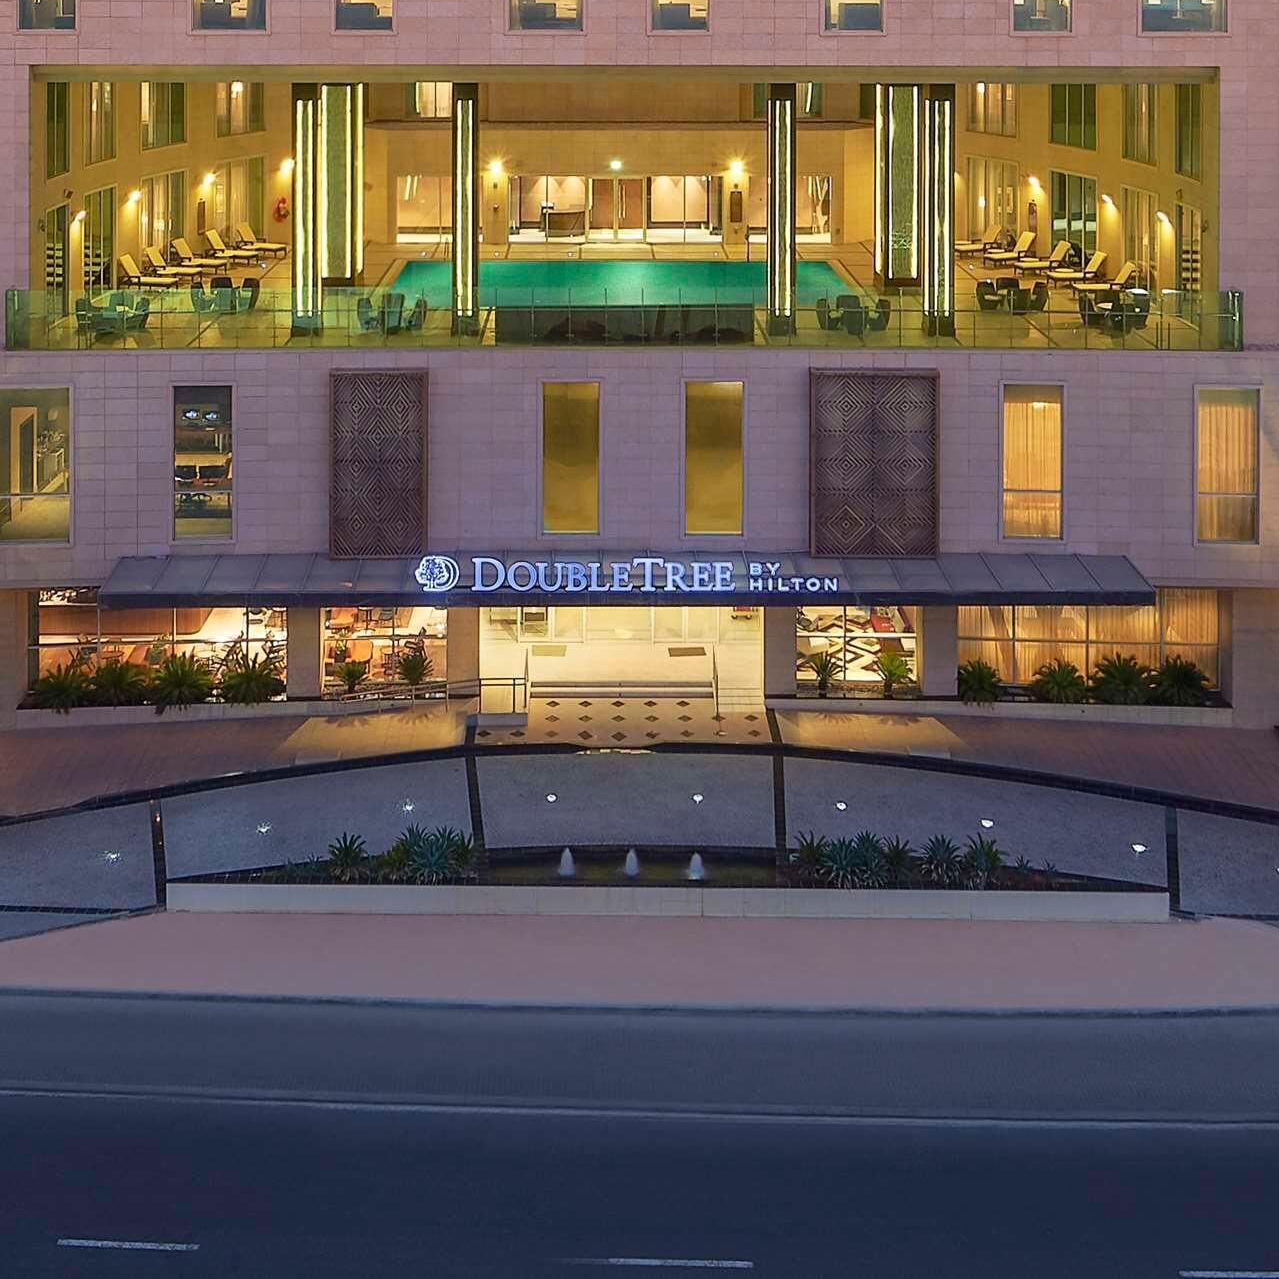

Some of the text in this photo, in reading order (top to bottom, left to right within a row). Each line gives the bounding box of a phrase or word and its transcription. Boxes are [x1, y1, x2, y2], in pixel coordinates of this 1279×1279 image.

[471, 557, 736, 592] DOUBLETREE
[749, 562, 781, 576] BY
[749, 577, 839, 592] HILTON
